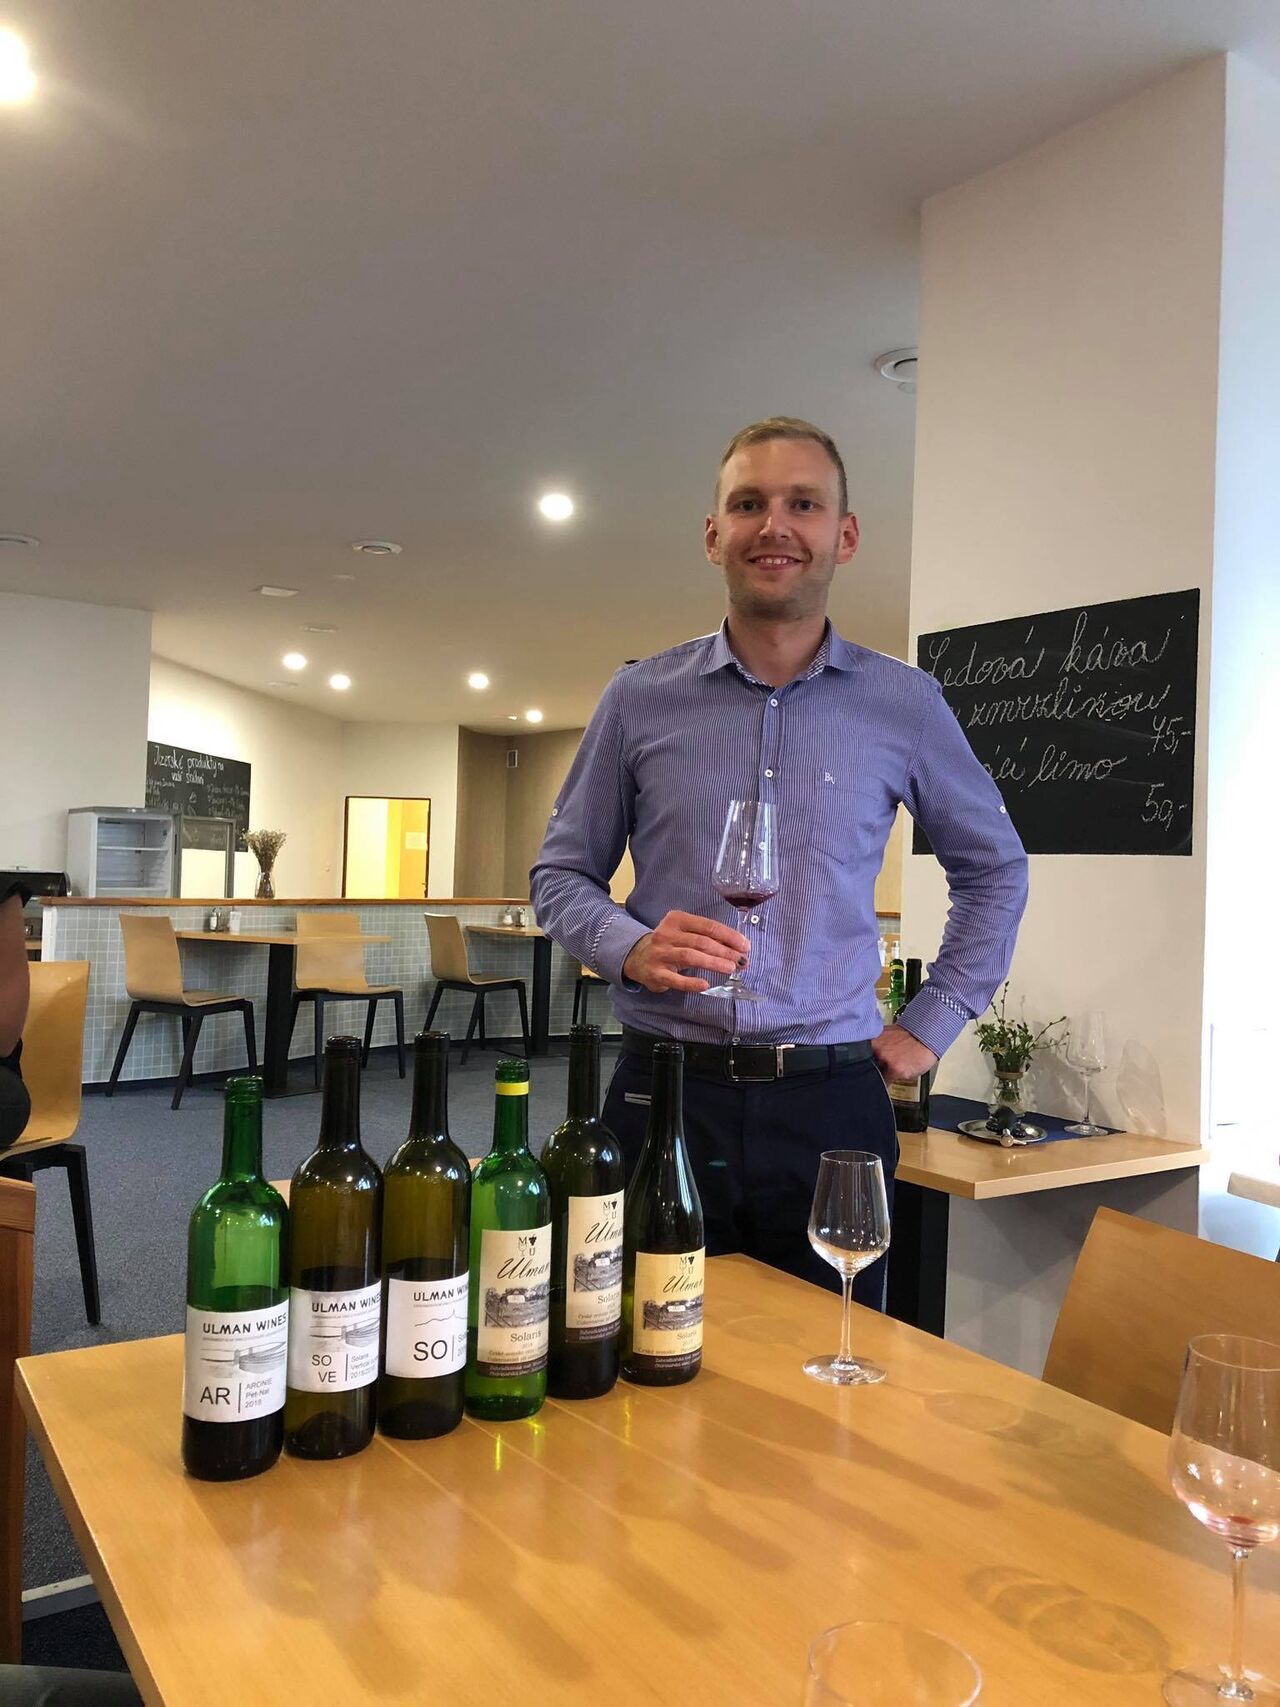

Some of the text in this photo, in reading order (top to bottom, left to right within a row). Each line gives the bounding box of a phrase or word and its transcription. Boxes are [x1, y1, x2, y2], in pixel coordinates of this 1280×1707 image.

[929, 611, 1170, 688] Ledová káva
[1027, 744, 1128, 788] limo
[585, 1221, 622, 1244] Ulma
[312, 1293, 380, 1313] ULMAN WINE
[413, 1289, 454, 1301] ULMAN
[203, 1312, 287, 1334] ULMAN WINES
[510, 1330, 542, 1342] Solaris
[312, 1354, 332, 1366] SO
[413, 1339, 448, 1361] SO
[318, 1371, 336, 1382] VE
[200, 1386, 231, 1405] AR
